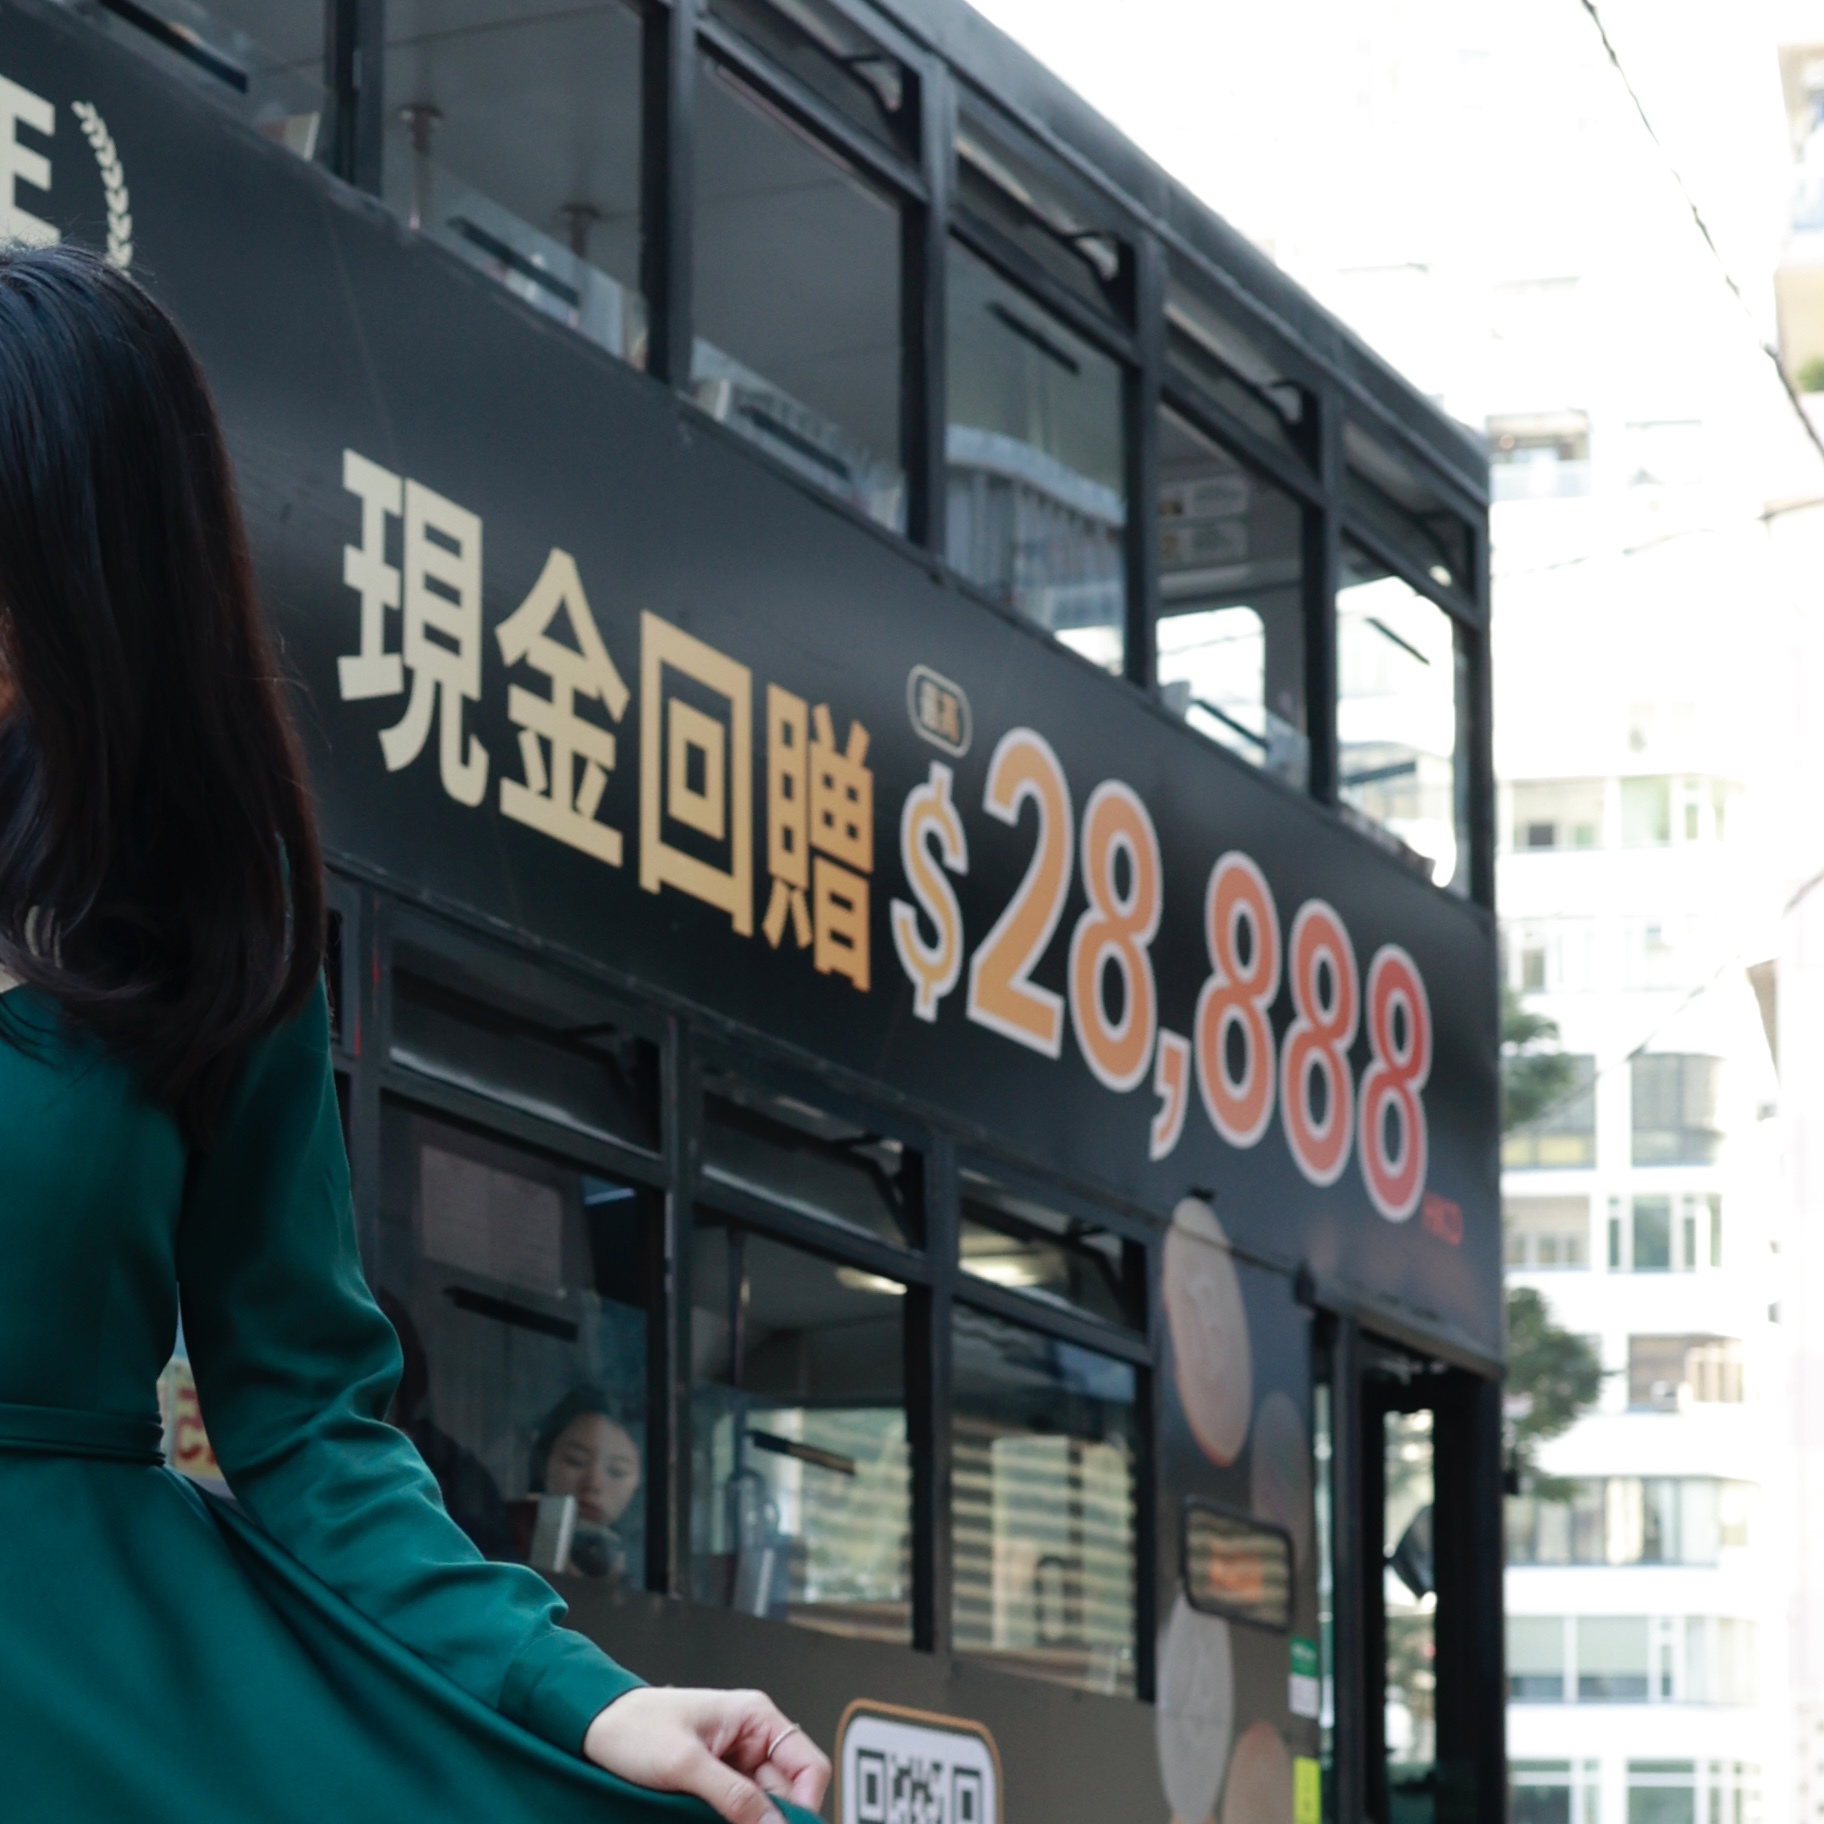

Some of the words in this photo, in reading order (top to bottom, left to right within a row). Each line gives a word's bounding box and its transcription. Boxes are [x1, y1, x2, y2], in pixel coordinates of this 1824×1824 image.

[338, 448, 873, 992] 現金回贈
[890, 727, 1432, 1222] $28,888
